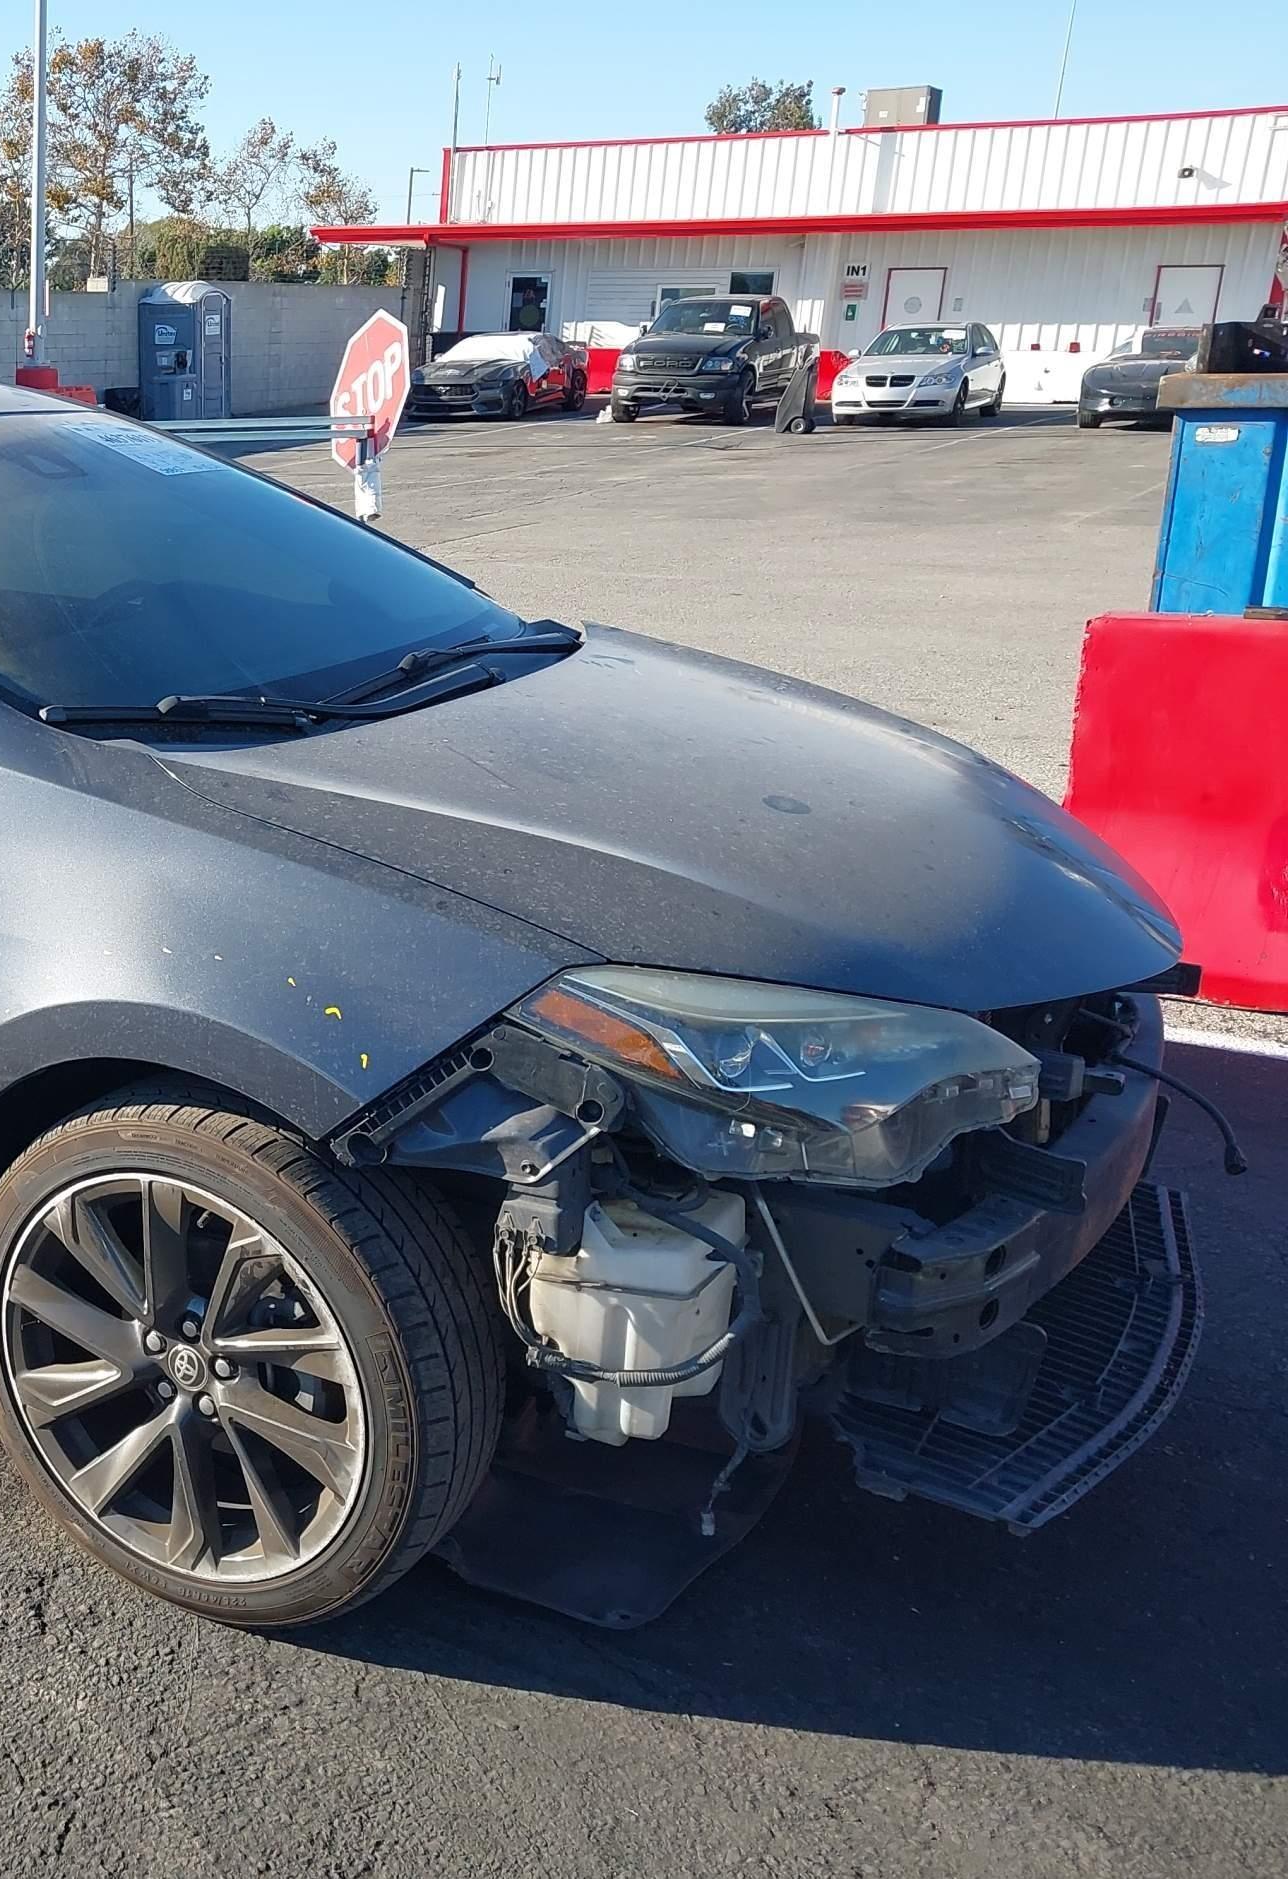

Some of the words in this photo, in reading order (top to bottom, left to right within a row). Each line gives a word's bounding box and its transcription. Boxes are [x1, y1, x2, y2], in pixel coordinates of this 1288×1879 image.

[846, 265, 867, 276] IN1
[640, 360, 693, 368] FORD
[335, 342, 402, 444] STOP
